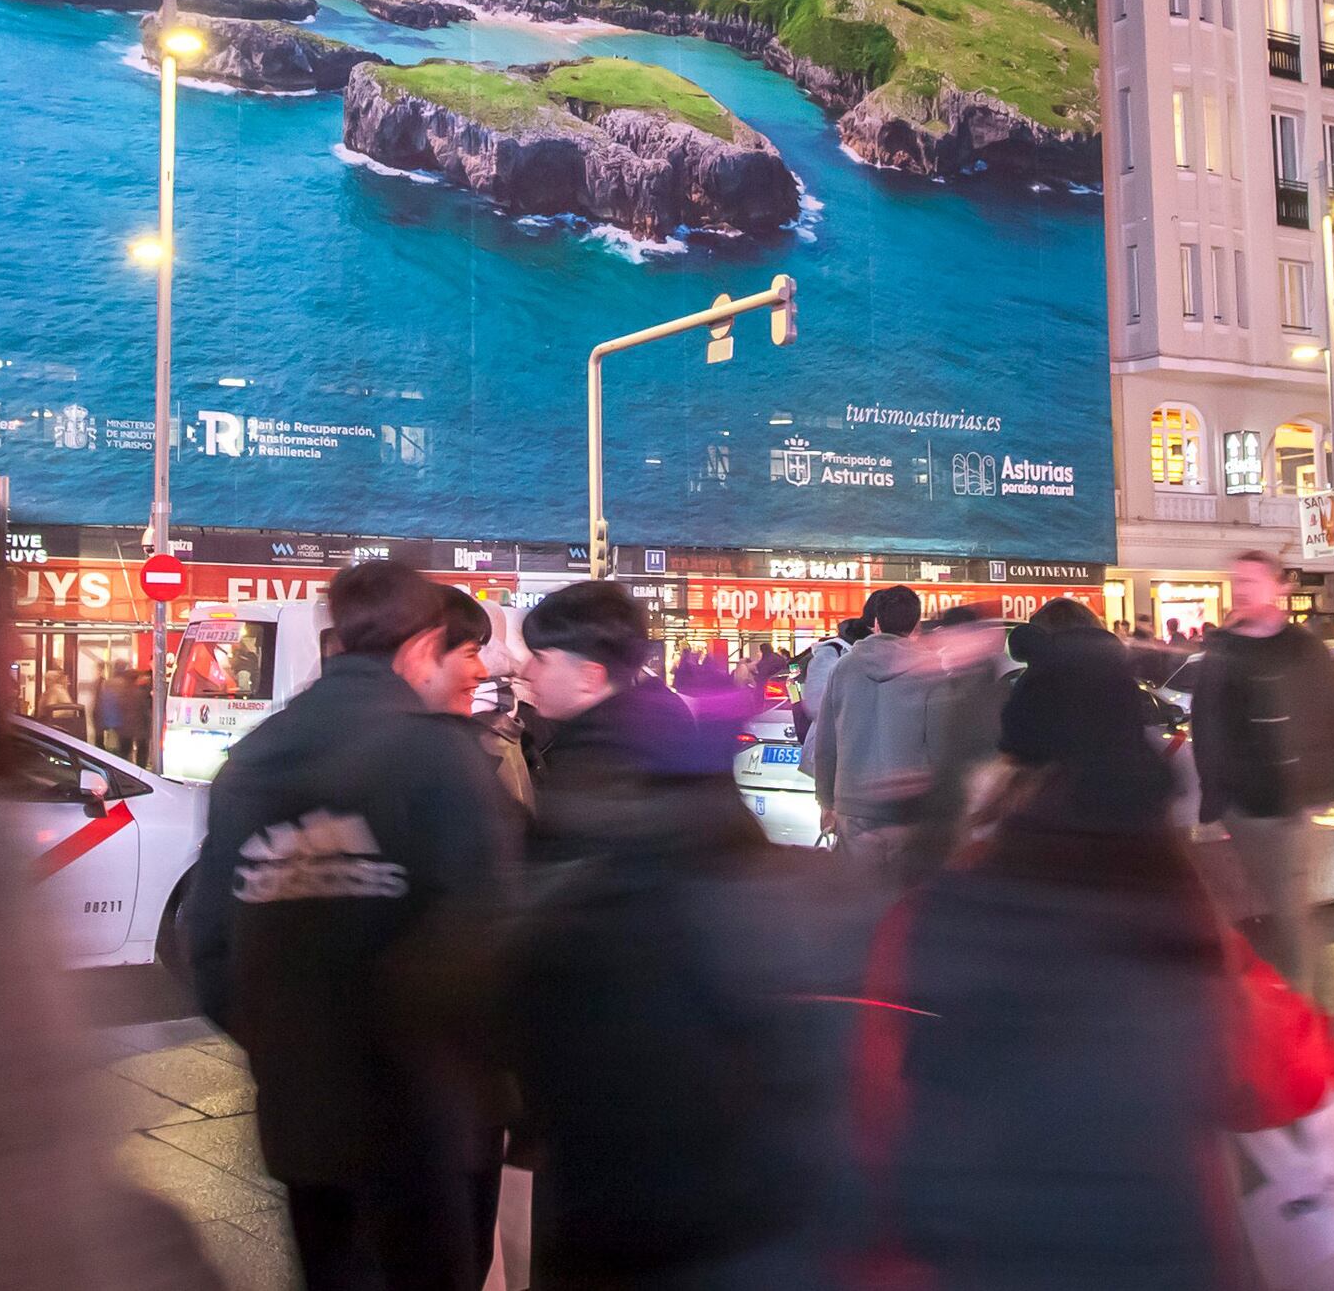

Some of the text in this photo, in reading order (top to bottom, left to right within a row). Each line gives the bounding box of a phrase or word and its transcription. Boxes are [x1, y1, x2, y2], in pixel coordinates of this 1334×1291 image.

[106, 419, 156, 431] MINISTERIO
[846, 402, 1002, 433] turismoasturias.es
[106, 429, 118, 439] DE
[247, 419, 376, 438] Plan de Recuperación,
[247, 431, 338, 448] Transformación
[247, 445, 322, 459] y Resiliencia
[821, 453, 893, 468] Principado de
[821, 467, 895, 487] Asturias
[1001, 456, 1075, 483] Asturias
[1001, 482, 1075, 497] paraíso natural
[770, 559, 806, 579] POP
[809, 560, 860, 580] MART
[1009, 565, 1089, 579] CONTINENTAL
[717, 589, 823, 621] POP MART
